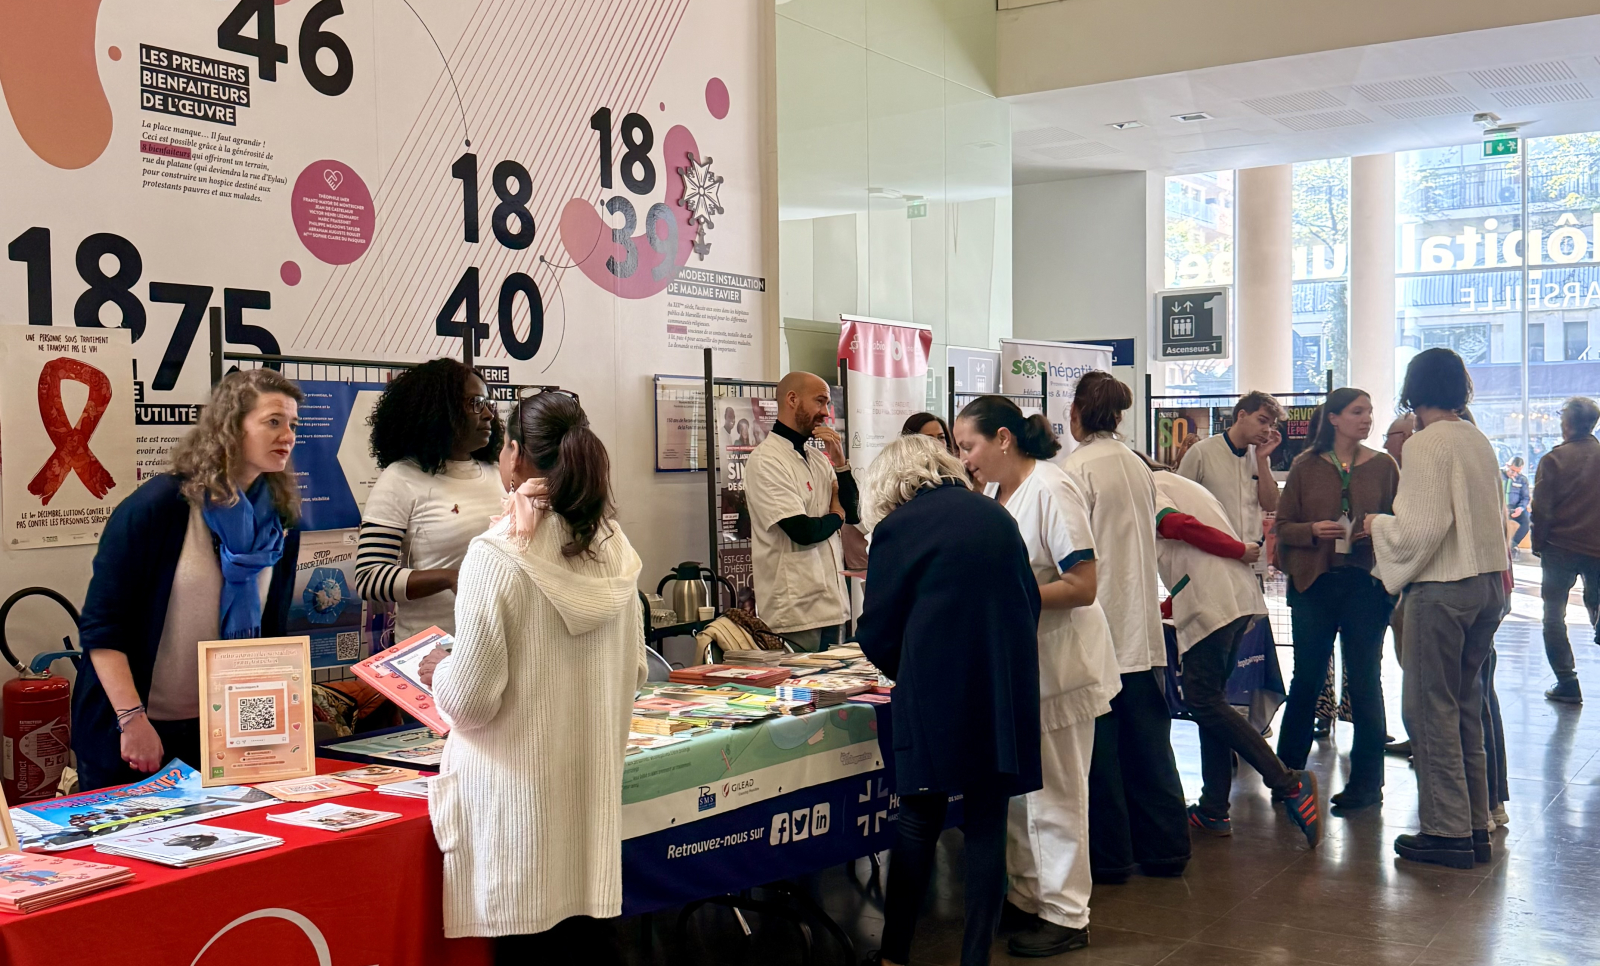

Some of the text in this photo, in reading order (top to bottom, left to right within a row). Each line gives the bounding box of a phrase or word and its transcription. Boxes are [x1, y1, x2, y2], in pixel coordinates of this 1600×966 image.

[217, 0, 353, 96] 46
[142, 48, 246, 83] LES PREMIERS
[142, 70, 248, 104] BIENFAITEURS
[143, 92, 234, 122] DE L'ŒUVRE
[142, 120, 151, 128] La
[153, 122, 171, 132] place
[217, 132, 231, 142] faut
[233, 136, 261, 147] agrandir
[142, 132, 274, 160] Ceci est possible grâce à la générosité de
[149, 144, 191, 158] bienfaiteurs
[192, 152, 203, 160] qui
[204, 154, 233, 165] offriront
[591, 106, 656, 195] 18
[167, 159, 192, 170] platane
[209, 164, 241, 177] deviendra
[242, 168, 248, 177] la
[142, 168, 159, 176] pour
[161, 170, 197, 181] construire
[209, 176, 233, 188] hospice
[235, 180, 257, 191] destiné
[258, 185, 271, 193] aux
[142, 179, 182, 191] protestants
[183, 185, 210, 195] pauvres
[452, 153, 535, 250] 18
[602, 195, 679, 282] 39
[8, 226, 147, 344] 18
[679, 269, 764, 289] MODESTE INSTALLATION
[668, 283, 739, 300] DE MADAME FAVIER
[436, 266, 544, 360] 40
[40, 334, 61, 342] PERSONNE
[65, 335, 77, 343] SOUS
[80, 335, 108, 343] TRAITEMENT
[47, 344, 69, 352] TRANSMET
[82, 345, 86, 353] LE
[1212, 343, 1216, 351] 1
[1011, 360, 1098, 381] SOS hépatit
[135, 405, 197, 421] 'UTILITÉ
[728, 483, 737, 491] DE
[63, 508, 85, 516] LUTTONS
[87, 507, 104, 516] CONTRE
[28, 519, 48, 528] CONTRE
[50, 518, 58, 526] LES
[60, 517, 89, 525] PERSONNES
[313, 550, 330, 559] STOP
[724, 555, 744, 563] EST-CE
[732, 779, 754, 791] GILEAD
[667, 831, 748, 859] Retrouvez-nous
[750, 827, 764, 841] sur
